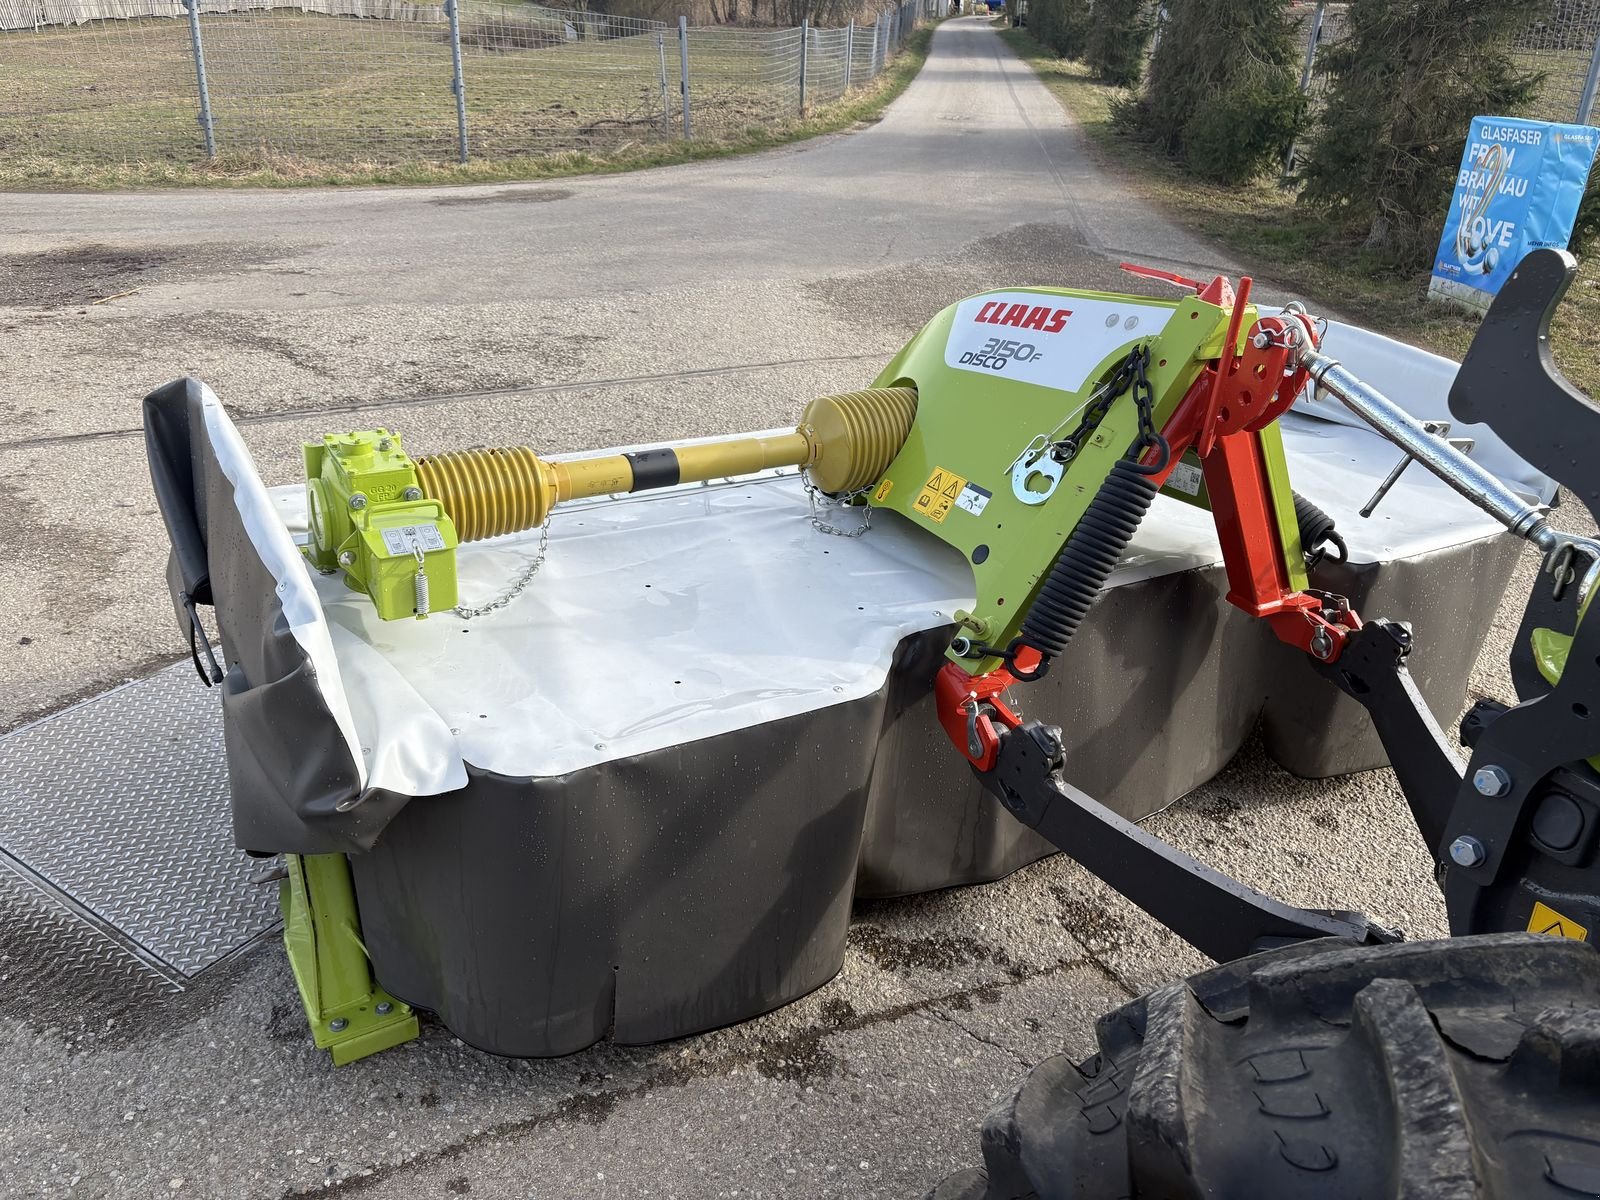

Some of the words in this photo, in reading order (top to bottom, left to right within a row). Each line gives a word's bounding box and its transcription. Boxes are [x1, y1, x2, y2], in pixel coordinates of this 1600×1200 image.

[1481, 126, 1542, 146] GLASFASER
[1461, 215, 1516, 248] LOVE
[974, 301, 1074, 334] CLAAS
[958, 351, 1008, 370] DISCO
